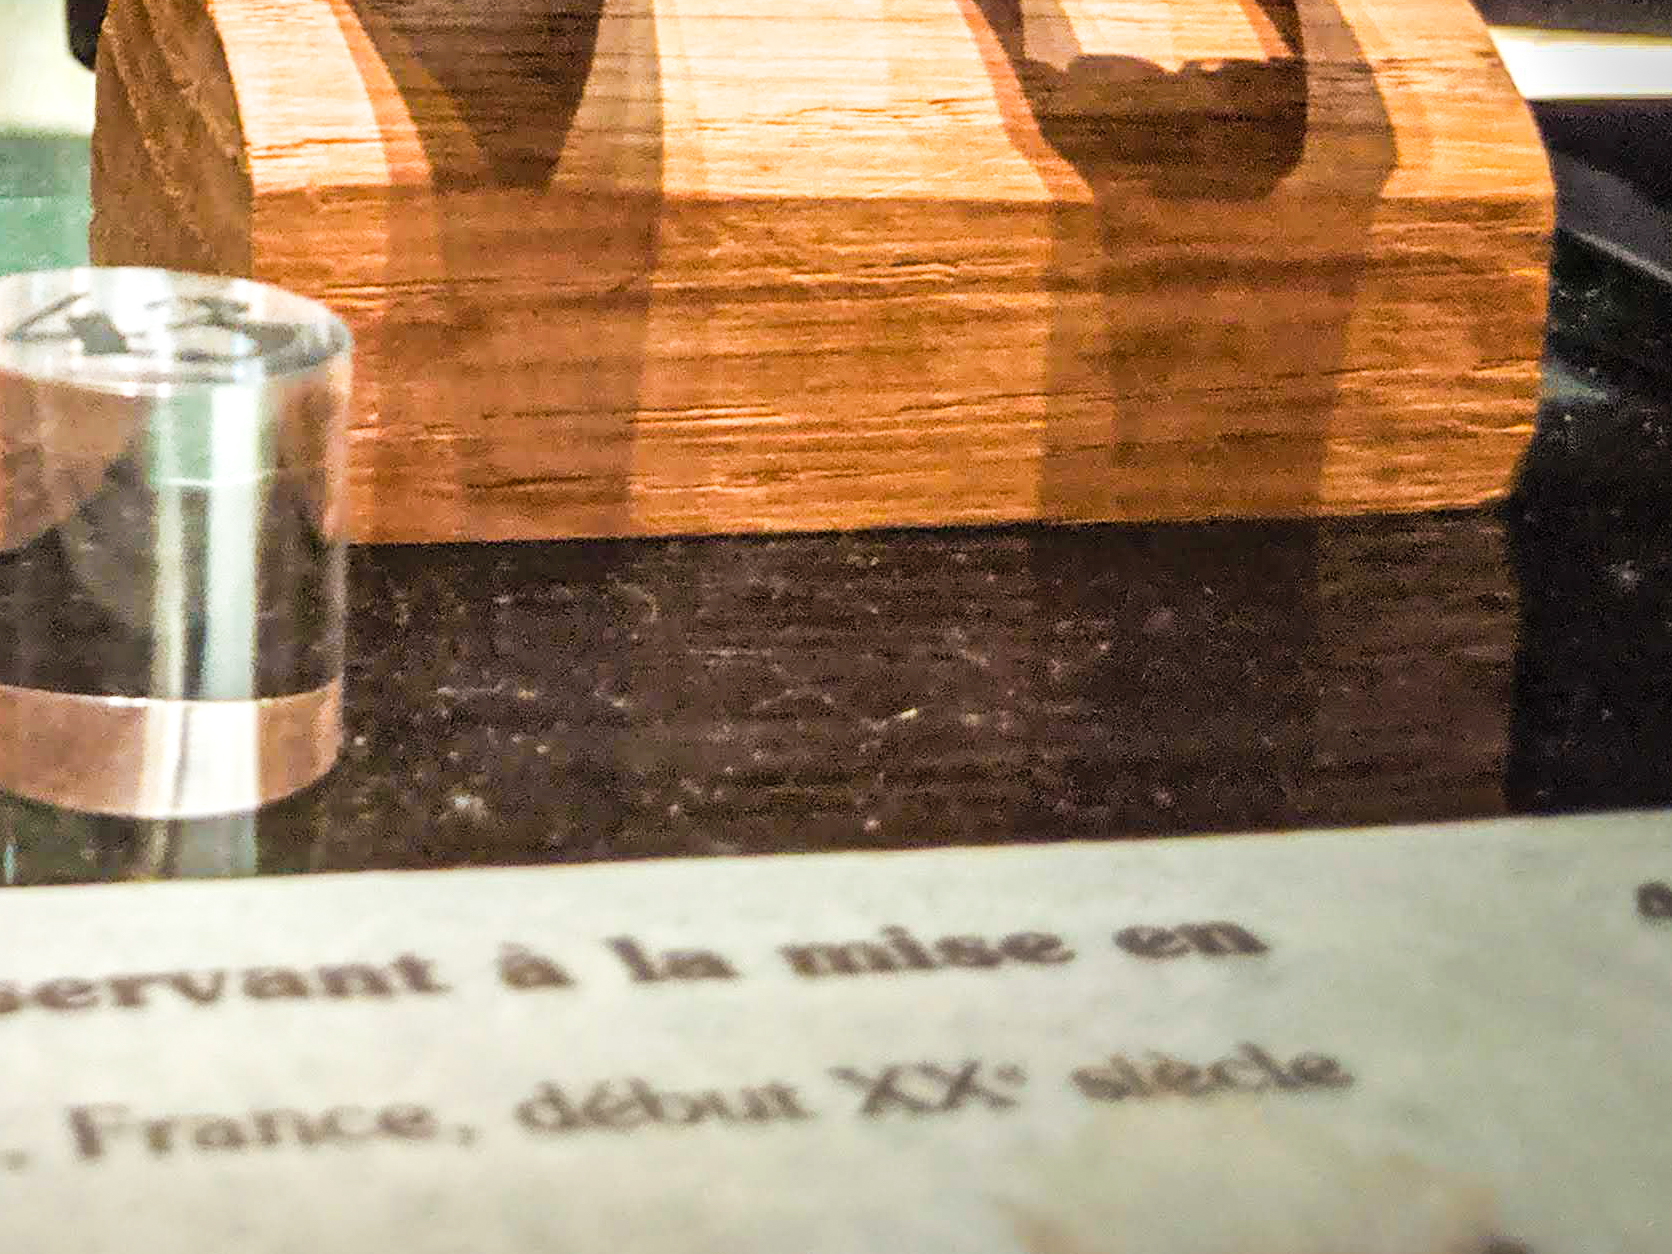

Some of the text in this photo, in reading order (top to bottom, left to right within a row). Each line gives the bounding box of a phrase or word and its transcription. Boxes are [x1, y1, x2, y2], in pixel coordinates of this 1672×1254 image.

[497, 936, 576, 991] à
[605, 934, 742, 985] la
[777, 924, 1077, 978] mise
[1114, 920, 1271, 961] en
[514, 1077, 816, 1132] début
[1071, 1041, 1356, 1104] siècle
